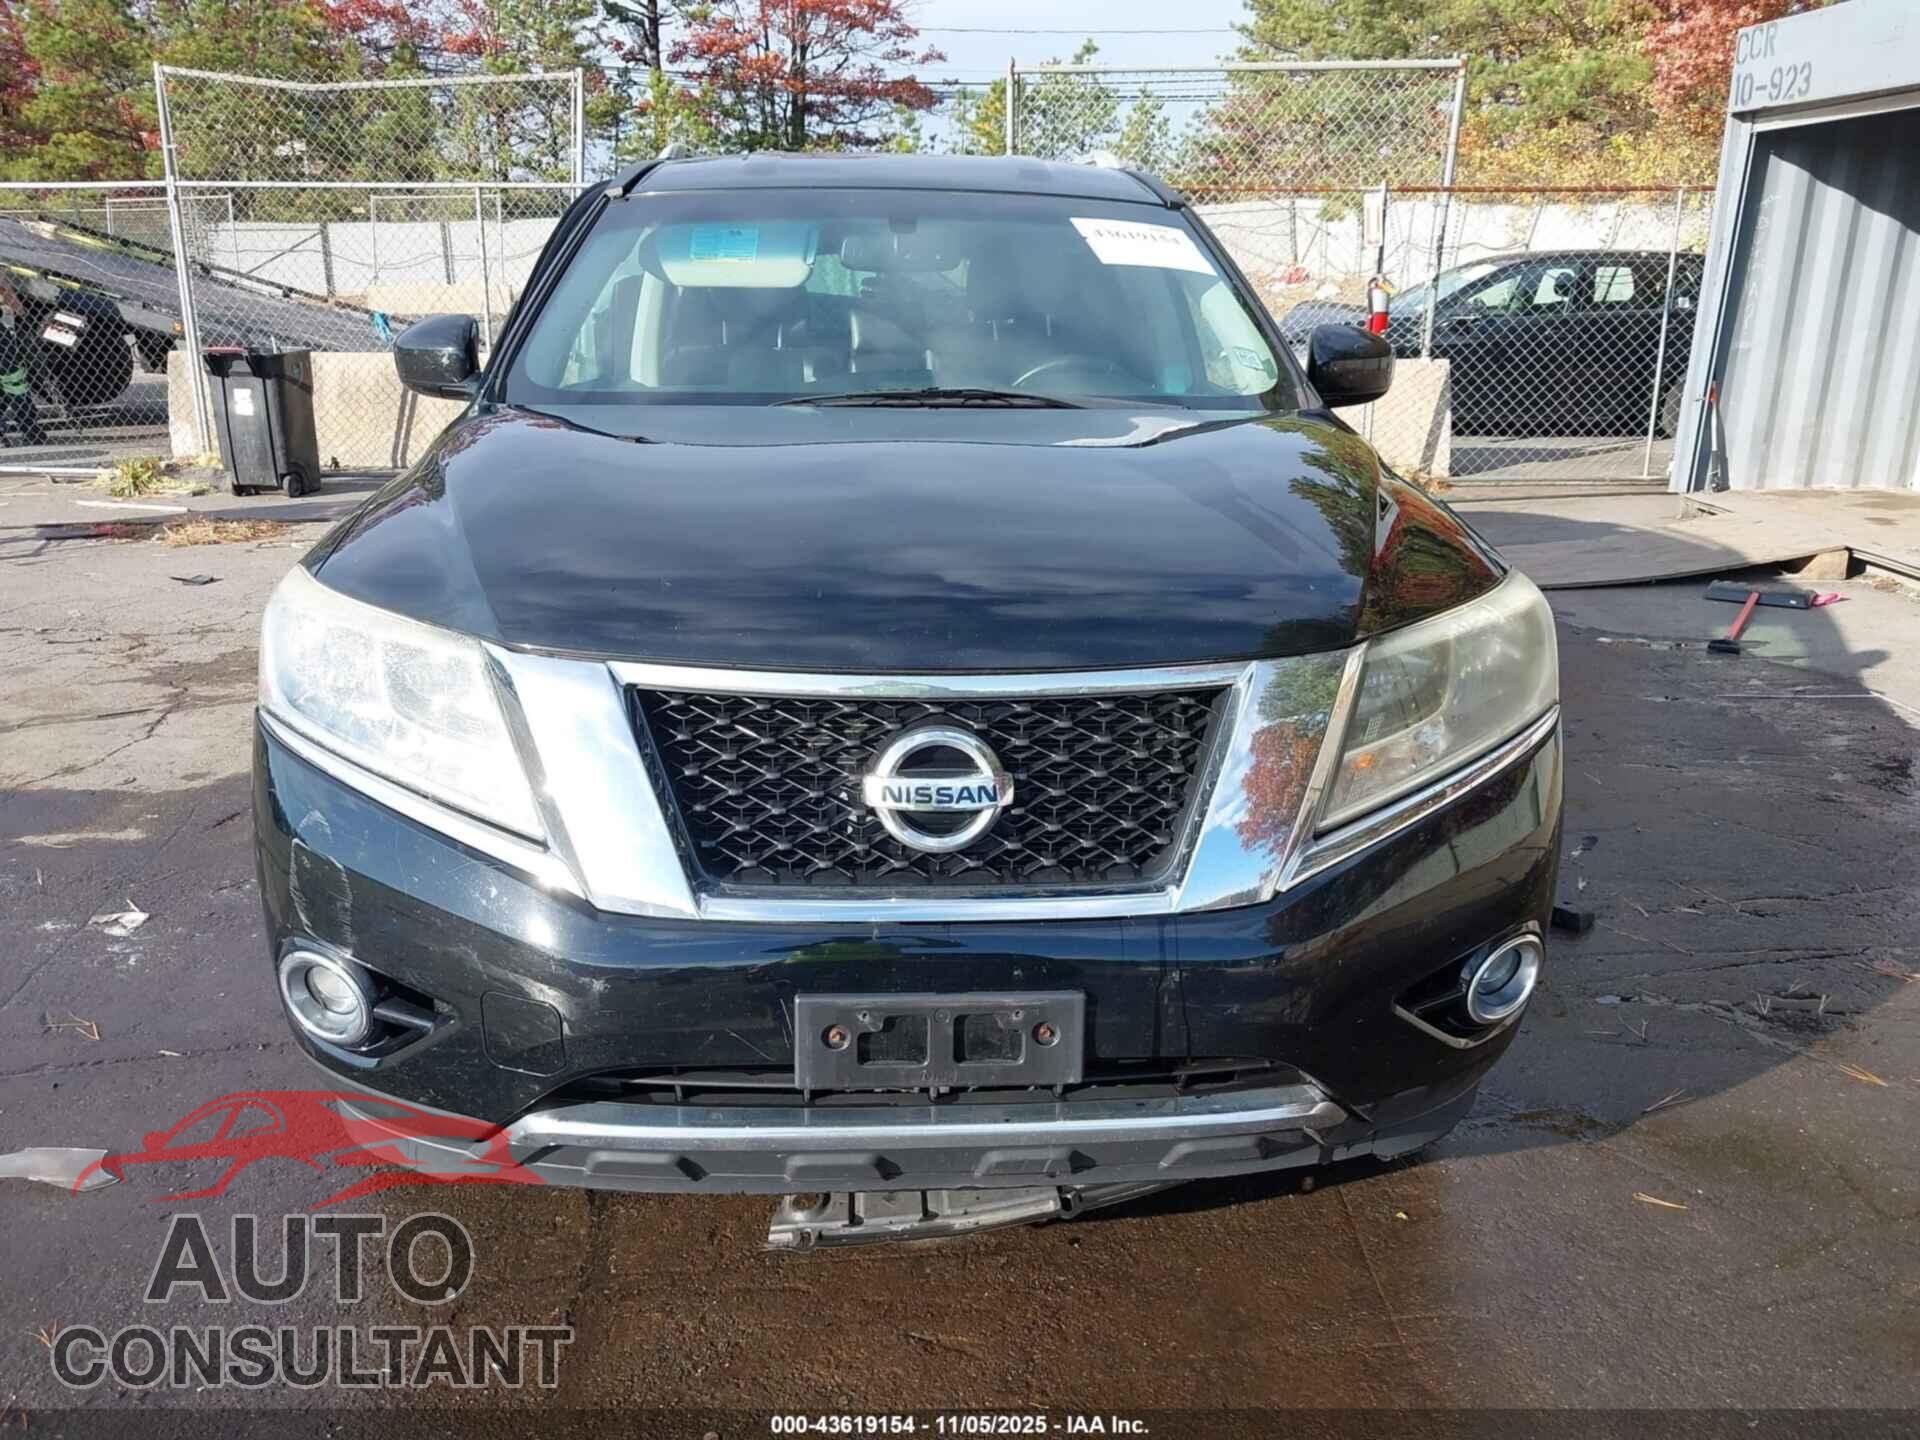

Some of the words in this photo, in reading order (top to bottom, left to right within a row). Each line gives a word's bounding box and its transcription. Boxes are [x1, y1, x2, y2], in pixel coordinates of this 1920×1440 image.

[1736, 23, 1777, 65] CCR
[1734, 61, 1812, 106] 10-923
[881, 785, 998, 804] NISSAN
